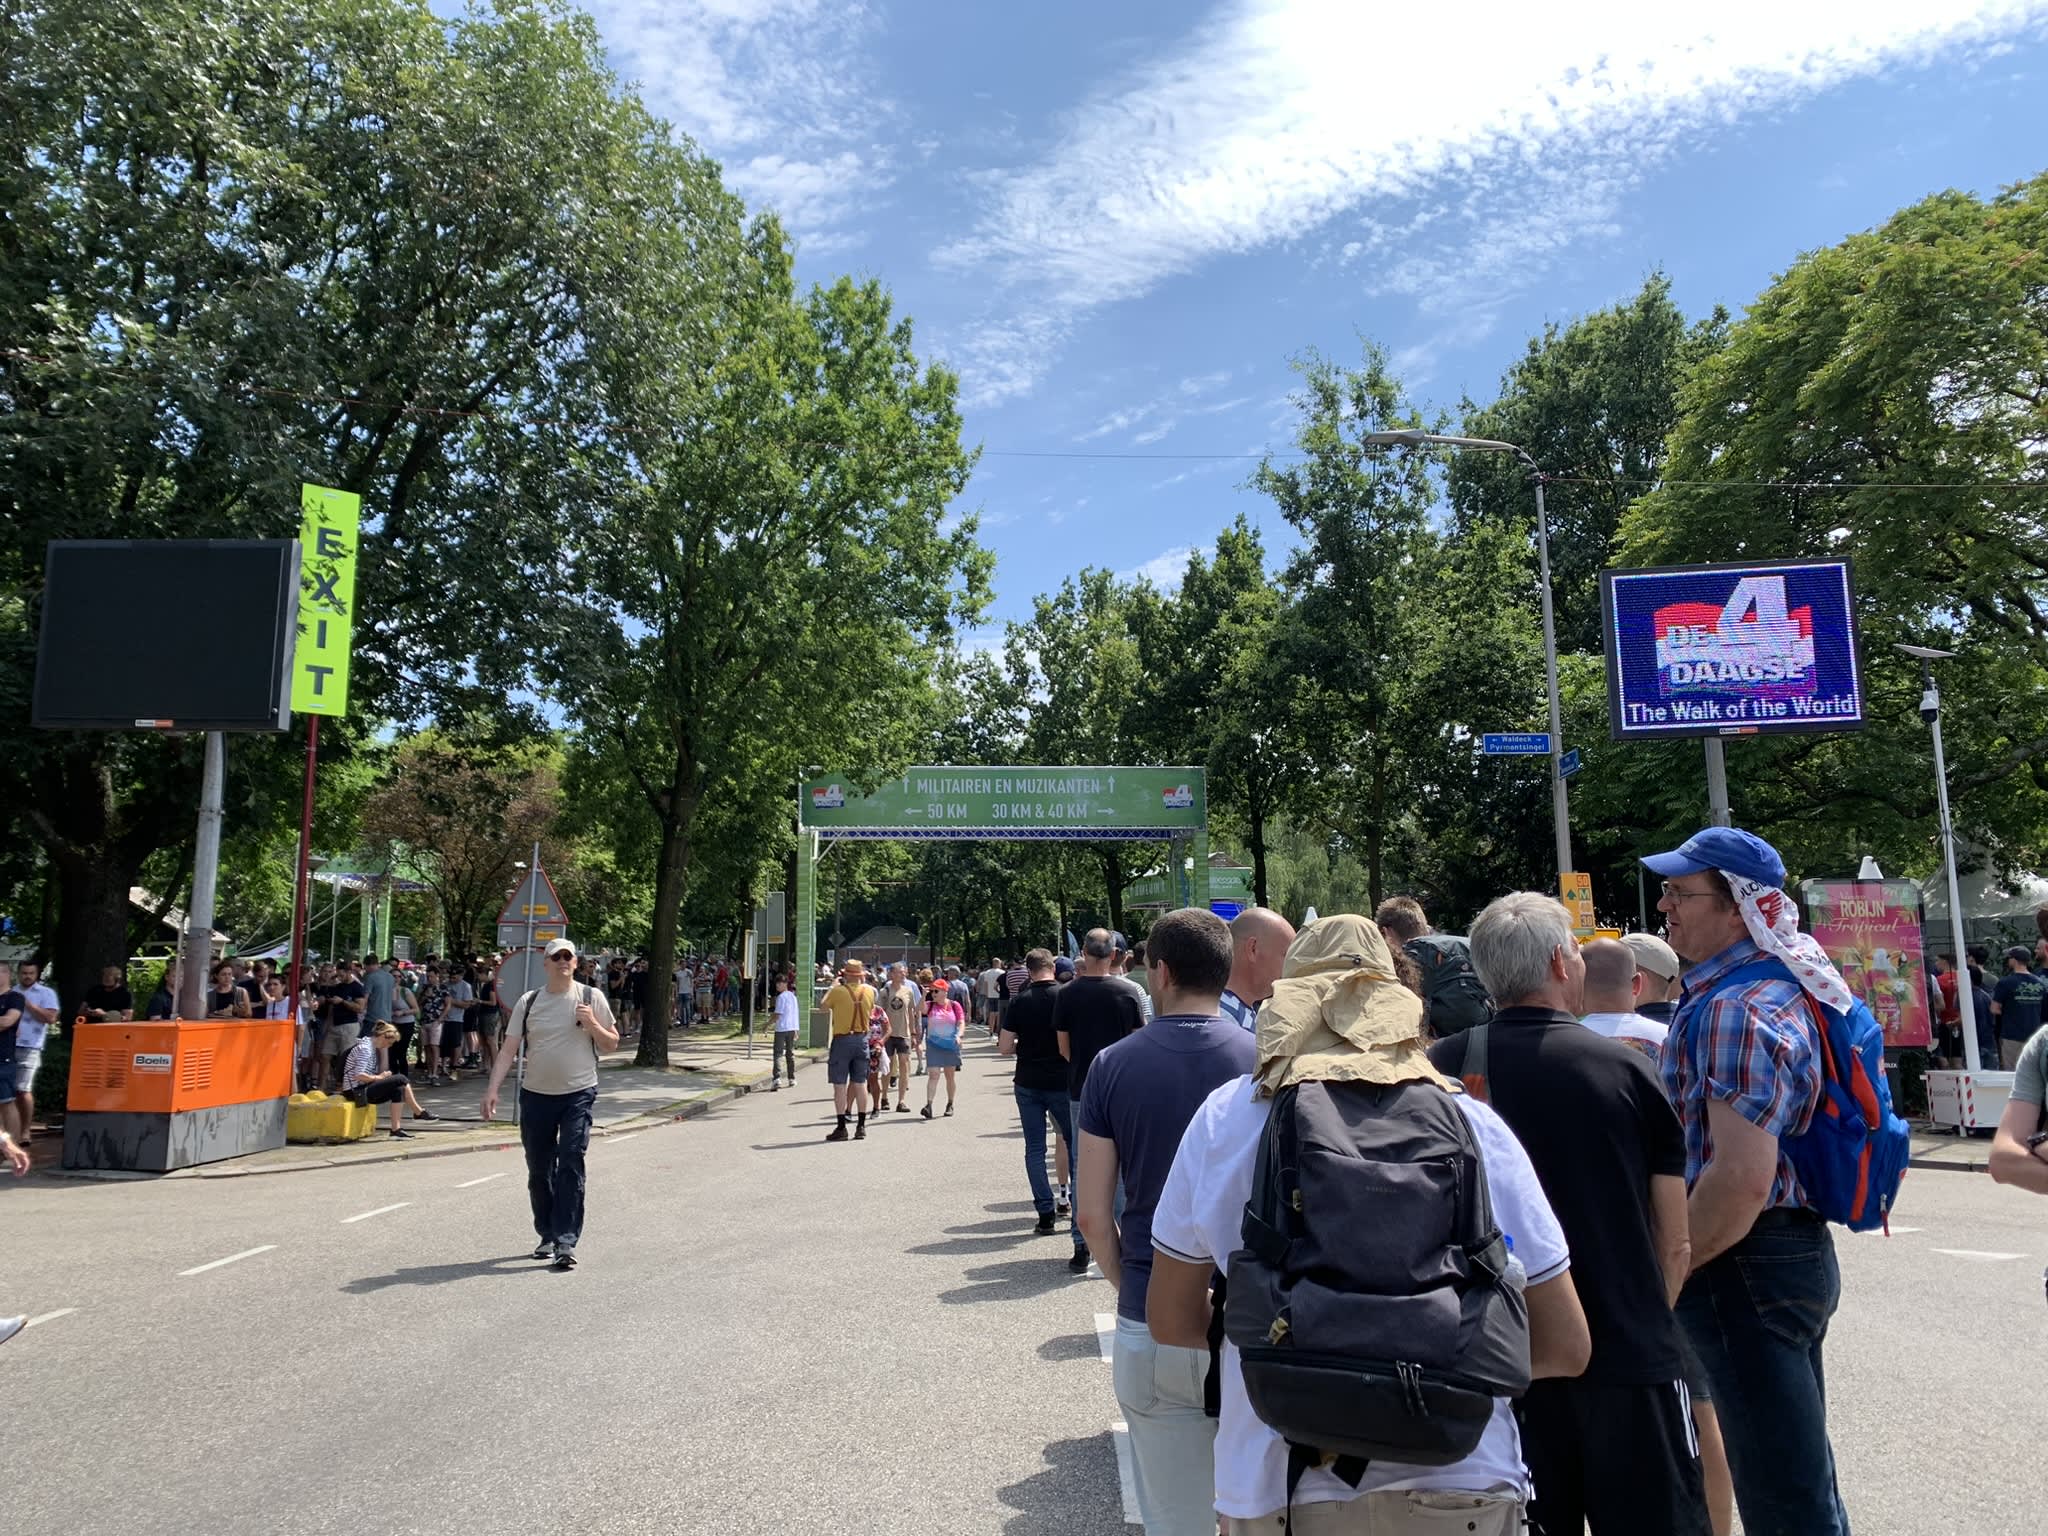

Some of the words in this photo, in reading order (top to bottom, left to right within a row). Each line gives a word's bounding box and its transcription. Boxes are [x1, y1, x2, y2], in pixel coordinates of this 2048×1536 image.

[305, 526, 343, 696] EXIT
[1716, 575, 1800, 655] 4
[1666, 624, 1712, 648] DE
[1669, 658, 1808, 685] DAAGSE
[1628, 702, 1667, 723] The
[1670, 699, 1722, 721] Walk
[1726, 698, 1747, 717] of
[1751, 698, 1788, 716] the
[1792, 693, 1854, 716] World
[1501, 735, 1532, 743] Waldeck
[1489, 743, 1545, 752] Pyrmontsingel
[917, 778, 991, 794] MILITAIREN
[995, 778, 1012, 794] EN
[1016, 778, 1100, 794] MUZIKANTEN
[927, 803, 943, 819] 50
[947, 803, 968, 819] KM
[991, 803, 1007, 819] 30
[1011, 803, 1032, 819] KM
[1035, 803, 1045, 819] &
[1048, 803, 1063, 819] 40
[1067, 803, 1088, 819] KM
[1577, 875, 1588, 887] 50
[1580, 888, 1590, 900] M
[1840, 900, 1886, 918] ROBIJN
[1582, 915, 1593, 927] 30
[1829, 917, 1899, 938] Tropical
